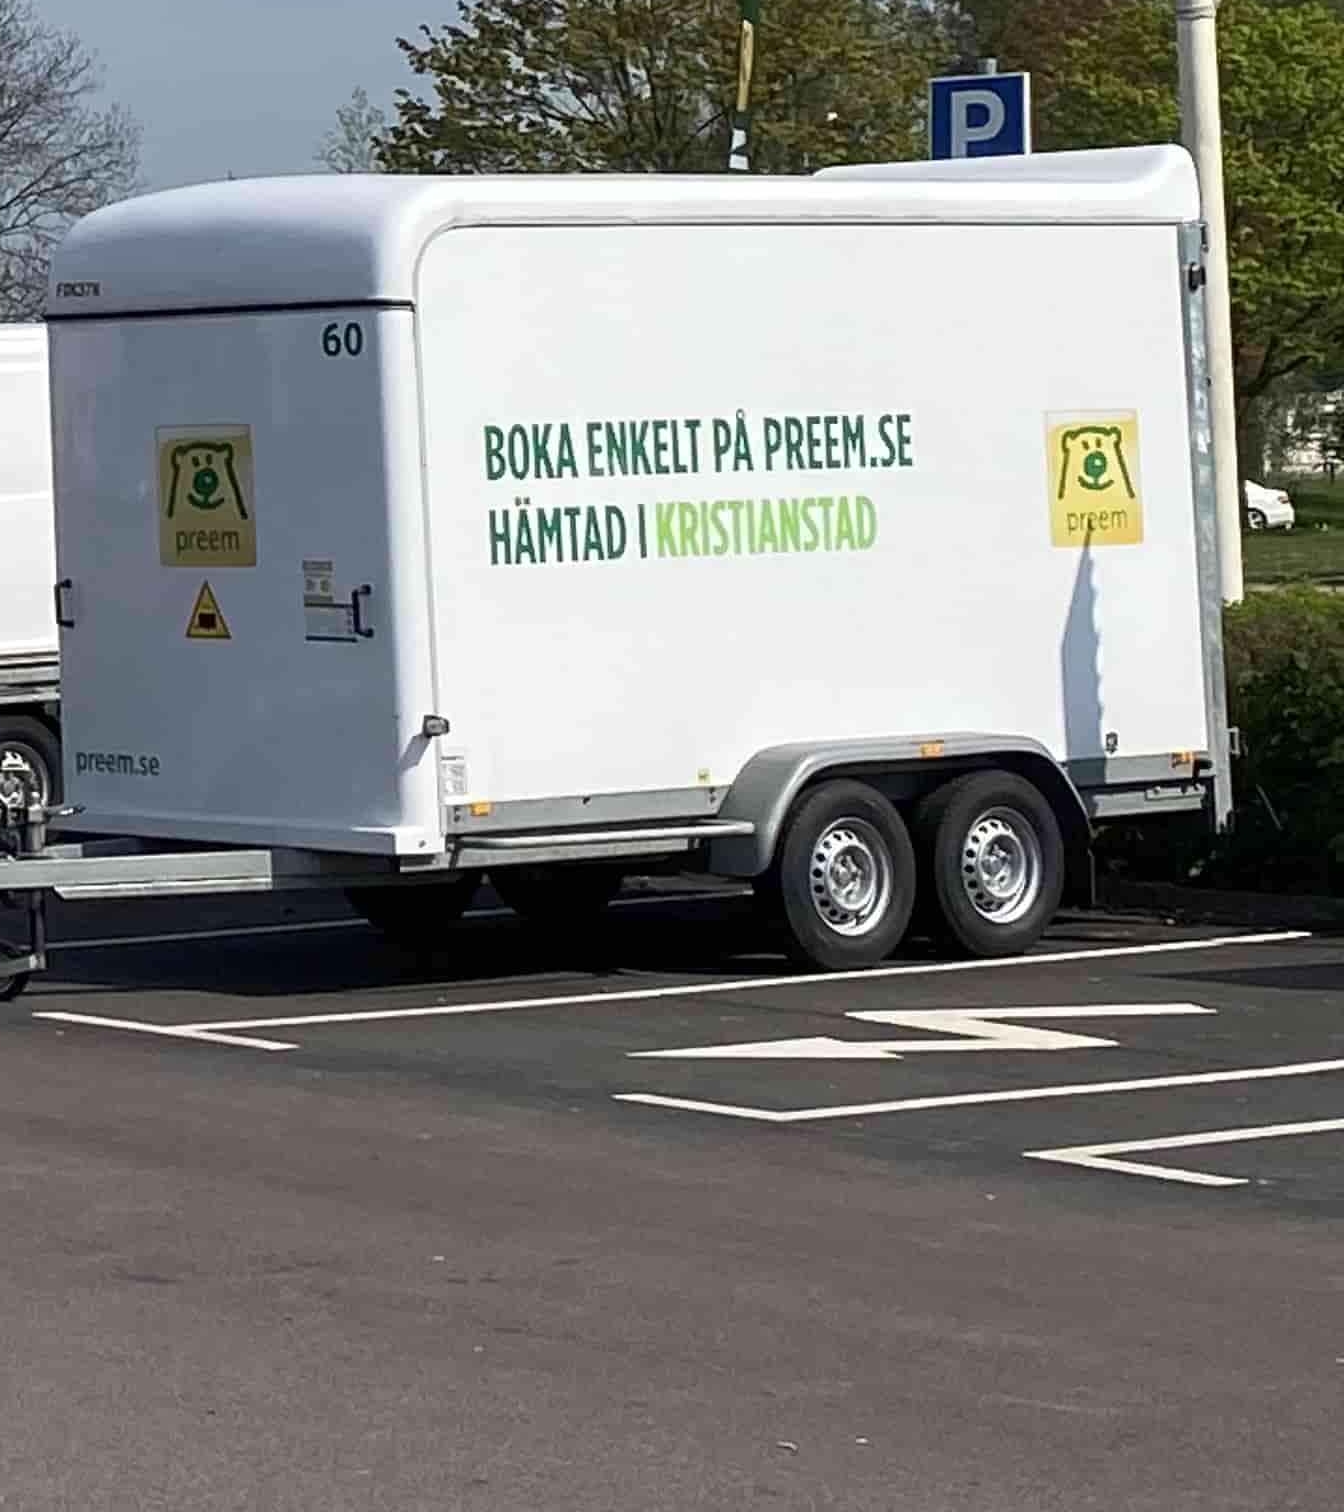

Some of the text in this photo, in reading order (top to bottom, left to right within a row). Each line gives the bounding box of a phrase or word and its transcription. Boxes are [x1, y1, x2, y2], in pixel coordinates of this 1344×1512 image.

[951, 89, 1005, 159] P
[323, 322, 363, 357] 60
[484, 408, 913, 481] BOKA ENKELT PÅ PREEM.SE
[489, 495, 878, 565] HÄMTAD I KRISTIANSTAD
[1067, 509, 1128, 536] preem
[176, 529, 240, 558] preem
[76, 752, 160, 777] preem.se
